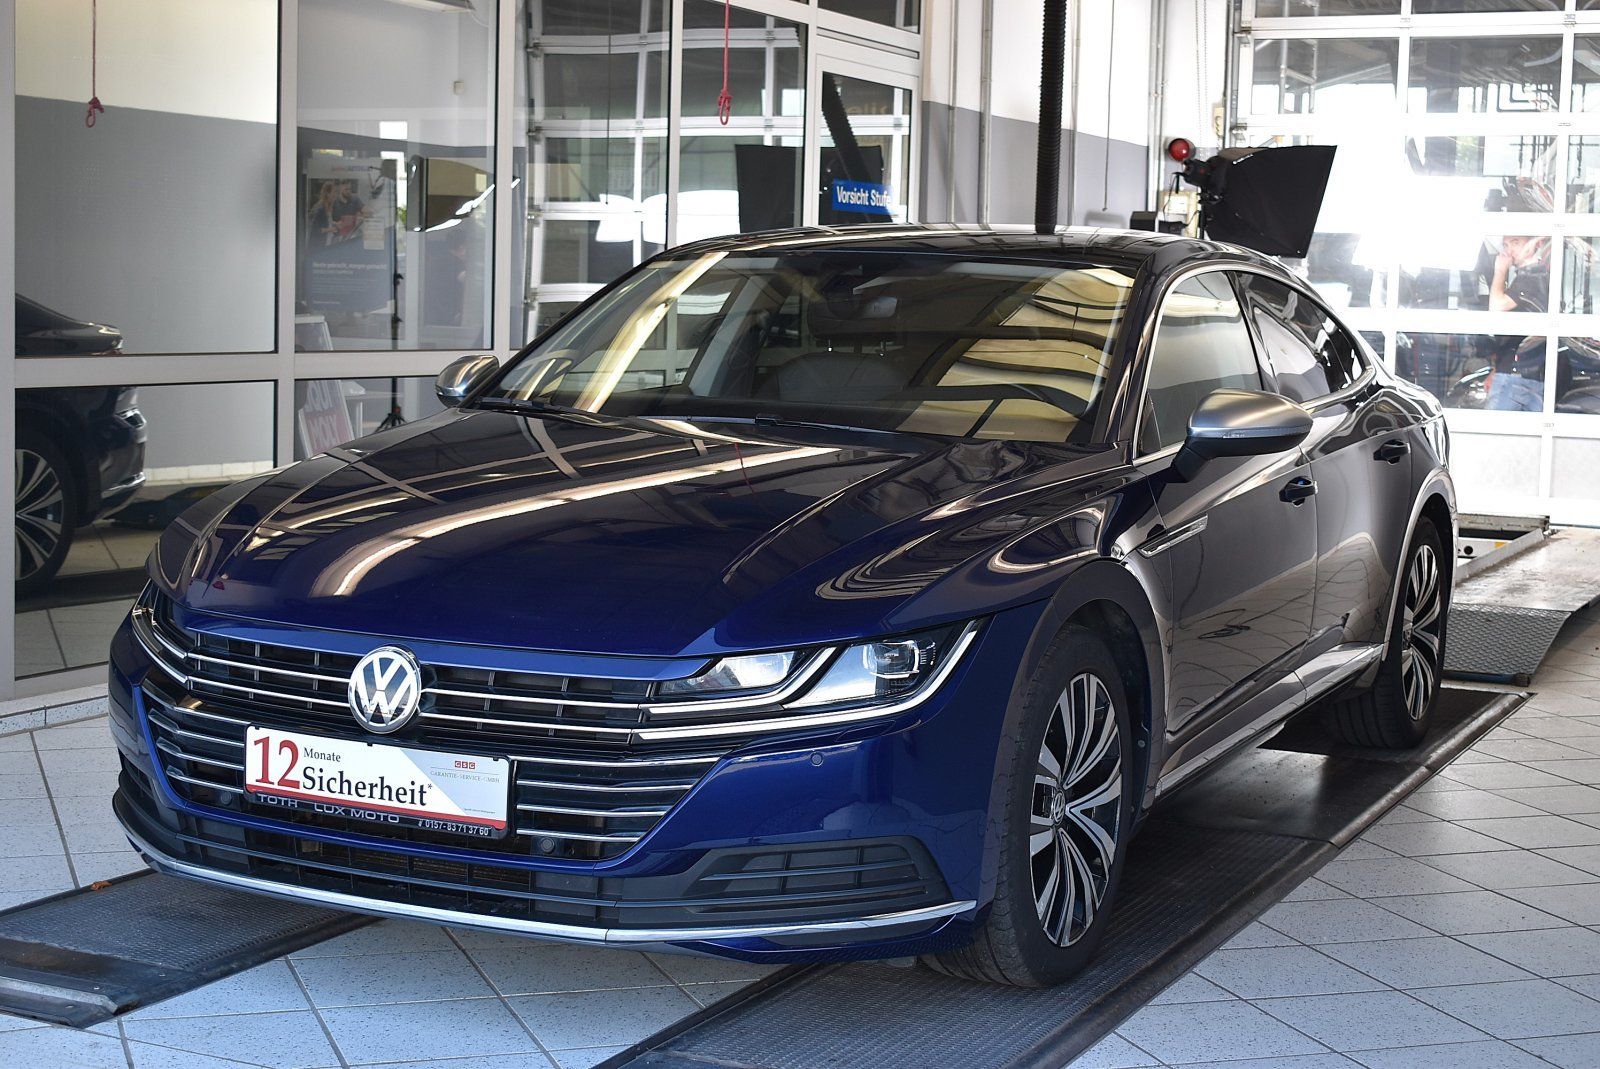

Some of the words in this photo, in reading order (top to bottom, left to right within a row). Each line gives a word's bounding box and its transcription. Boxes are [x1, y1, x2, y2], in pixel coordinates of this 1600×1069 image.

[836, 185, 869, 206] Vorsicht
[253, 735, 300, 790] 12
[303, 747, 341, 763] Monate
[256, 793, 298, 808] TOTH
[314, 802, 346, 816] LUX
[350, 808, 400, 823] MOTO
